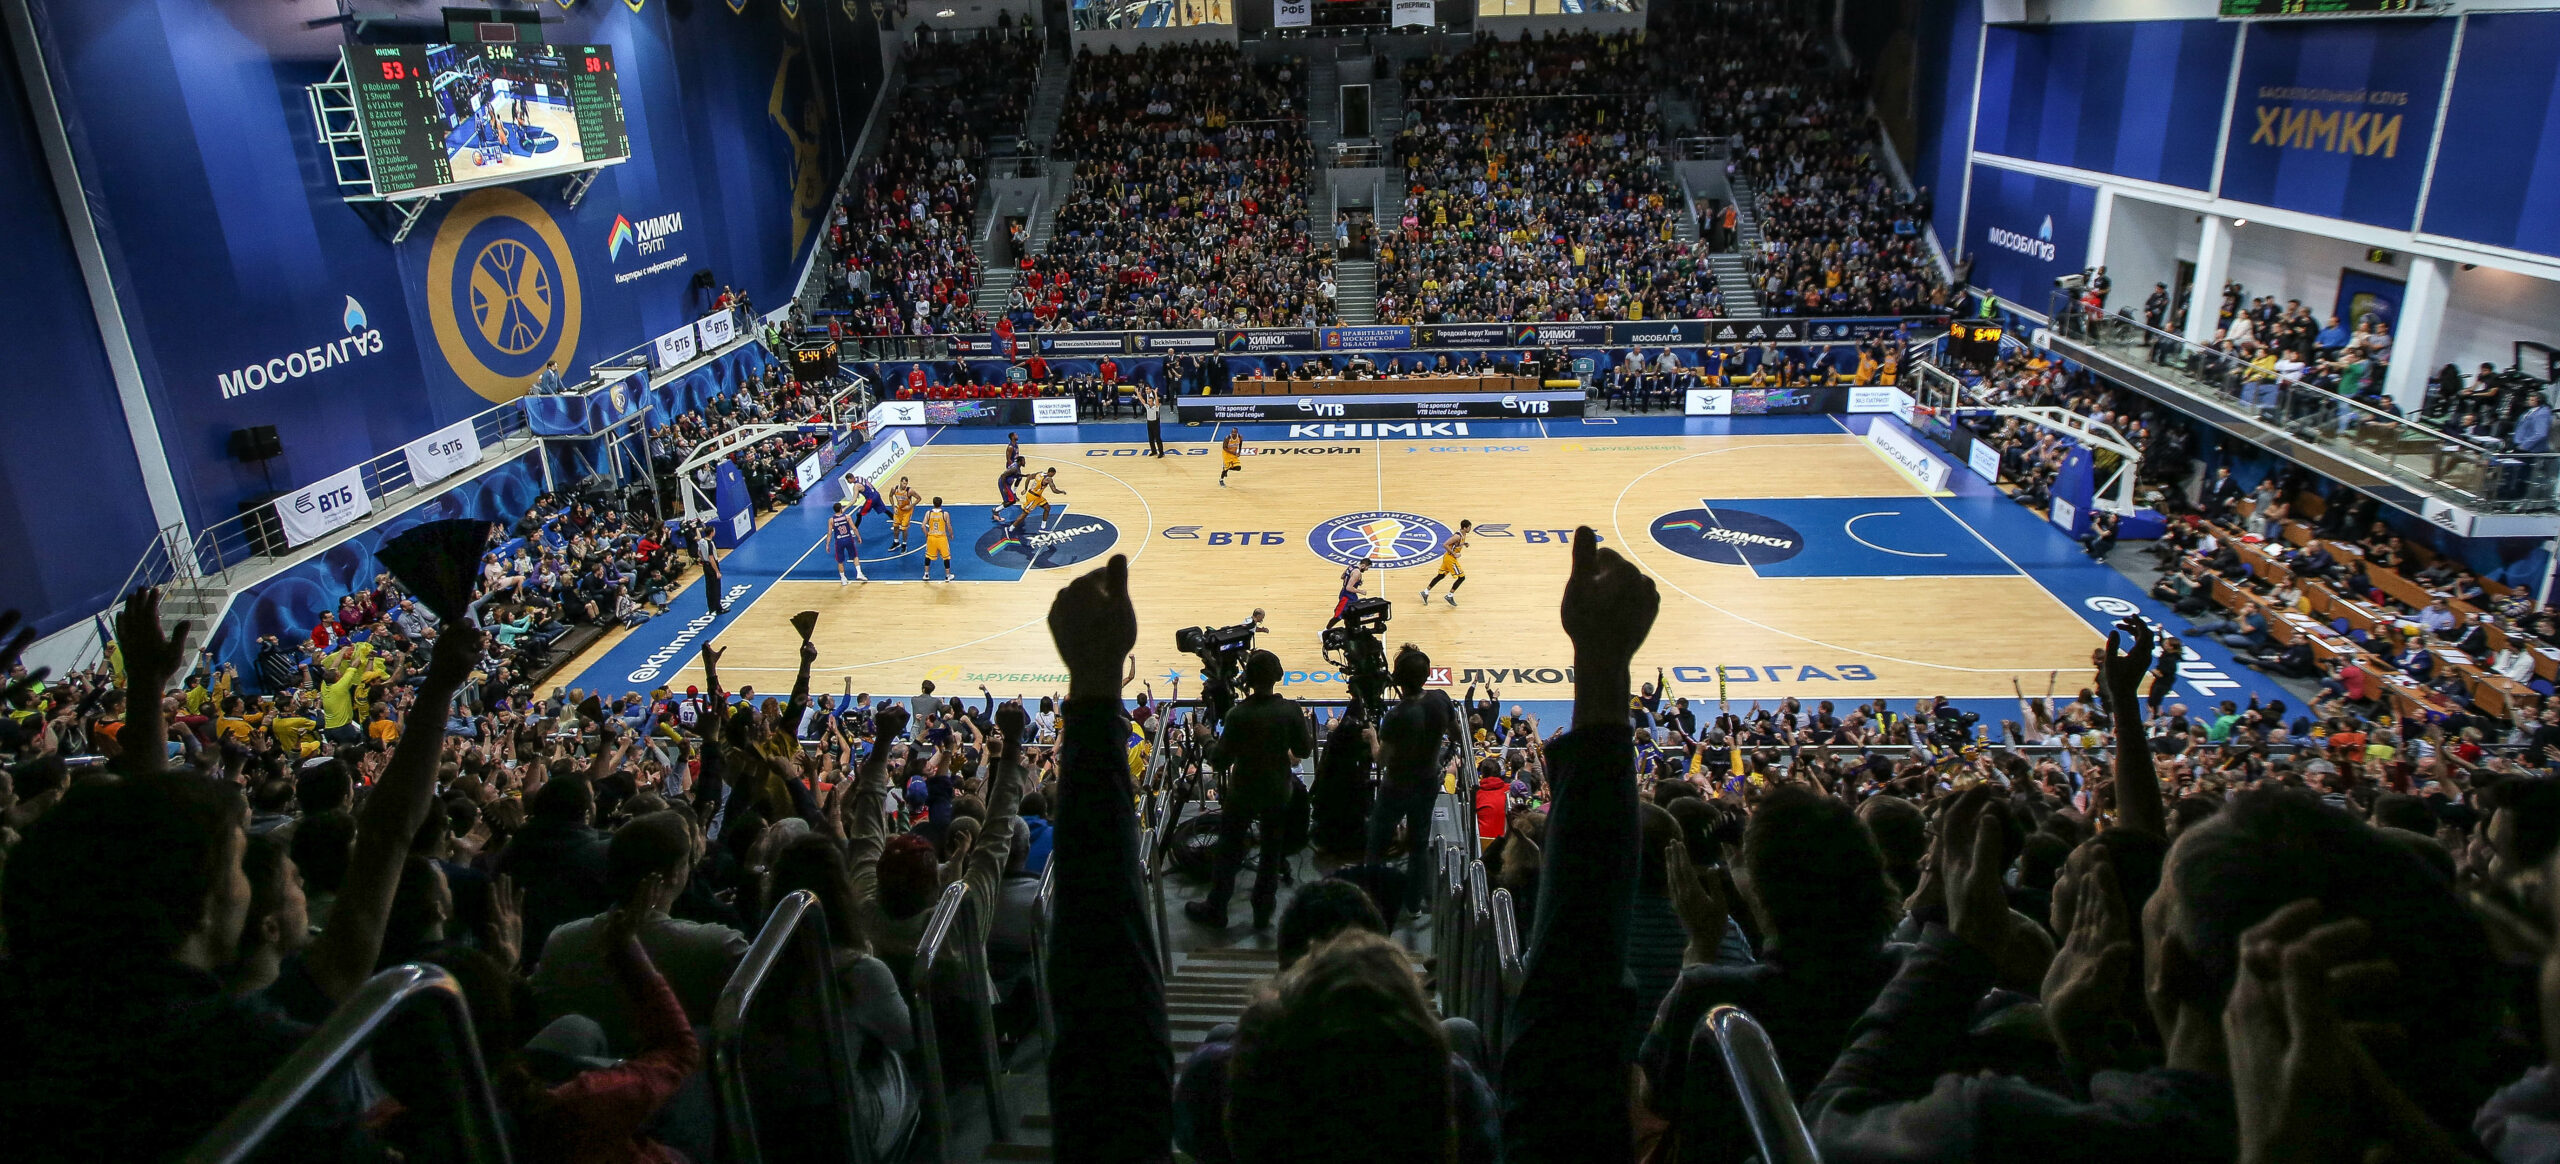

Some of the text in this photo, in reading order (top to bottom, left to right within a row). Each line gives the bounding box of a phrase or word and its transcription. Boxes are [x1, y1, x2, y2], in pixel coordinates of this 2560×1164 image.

[1281, 5, 1305, 14] РФБ
[1396, 1, 1431, 10] СУПЕРЛИГА
[375, 47, 401, 56] KHIMKI
[486, 45, 514, 59] 5:44
[546, 44, 555, 58] 3
[382, 61, 405, 80] 53
[585, 57, 602, 72] 58
[368, 82, 400, 91] Robinson
[370, 92, 391, 101] Shved
[2369, 91, 2409, 106] КЛУБ
[2250, 105, 2403, 158] ХИМКИ
[634, 211, 683, 242] ХИМКИ
[638, 237, 666, 256] ГРУПП
[1989, 226, 2055, 262] МОСОБЛГАЗ
[714, 319, 729, 334] ВТБ
[1342, 329, 1404, 337] ПРАВИТЕЛЬСТВО
[1437, 329, 1467, 337] Городской
[1248, 335, 1285, 344] ХИМКИ
[1538, 329, 1575, 339] ХИМКИ
[1632, 334, 1682, 342] МОСОБЛГАЗ
[674, 336, 690, 352] ВТБ
[798, 351, 820, 361] 5:44
[218, 329, 384, 399] МОСОБЛГАЗ
[1315, 404, 1345, 416] VTB
[1519, 400, 1549, 413] VTB
[1245, 411, 1265, 419] League
[1288, 422, 1469, 438] KHIMKI
[442, 438, 463, 456] ВТБ
[1085, 448, 1209, 457] СОГАЗ
[1259, 446, 1361, 454] ЛУКОЙЛ
[866, 447, 905, 484] ОСОБЛГАЗ
[1876, 436, 1930, 482] МОСОБЛГАЗ
[318, 485, 353, 513] ВТБ
[1328, 512, 1437, 527] ЕДИНАЯ ЛИГА ВТБ
[1026, 523, 1104, 545] ХИМКИ
[1208, 532, 1286, 545] ВТБ
[1702, 533, 1749, 547] ГРУПП
[1709, 527, 1793, 549] ХИМКИ
[1327, 552, 1347, 563] VTB
[1397, 551, 1438, 567] LEAGUE
[628, 584, 752, 683] @Khimkibsket
[1672, 664, 1878, 683] СОГАЗ
[683, 711, 695, 722] 97
